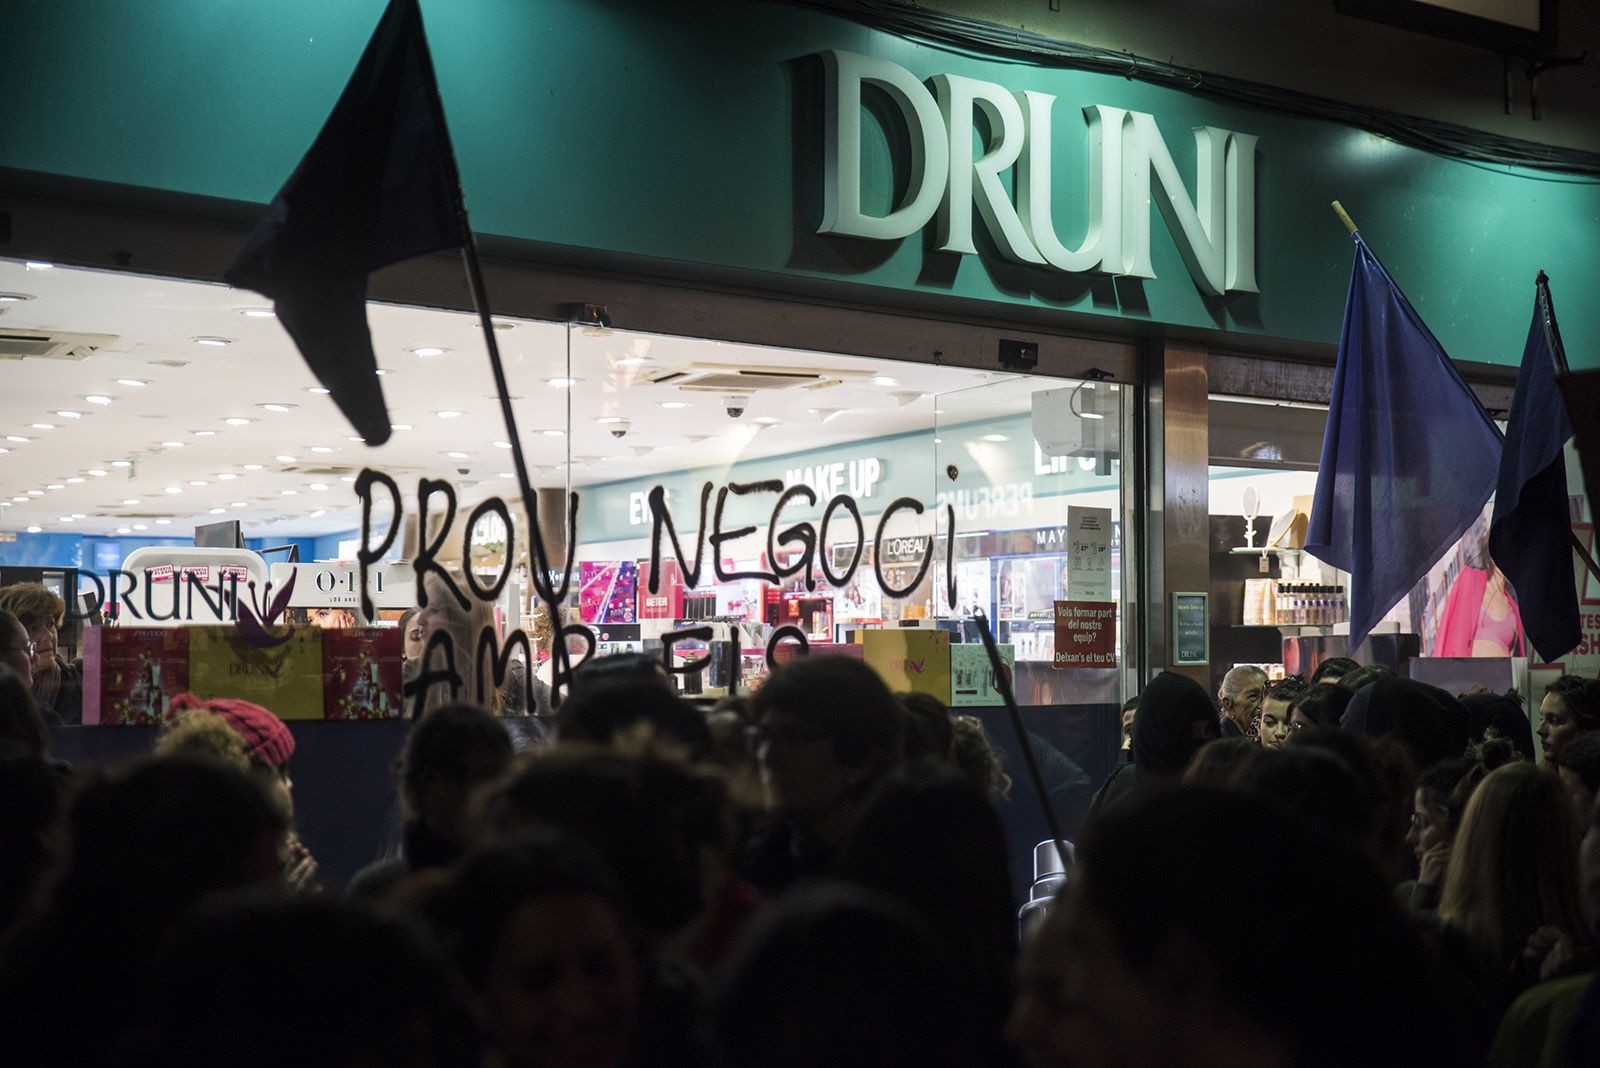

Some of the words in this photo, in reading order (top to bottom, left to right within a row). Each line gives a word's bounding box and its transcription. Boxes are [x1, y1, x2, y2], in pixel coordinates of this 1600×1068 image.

[816, 49, 1260, 296] DRUNI
[785, 462, 845, 506] MAKE
[850, 457, 880, 498] UP
[648, 464, 959, 610] NEGOCI
[64, 569, 240, 621] DRUNI
[1058, 606, 1073, 617] Vols
[1074, 607, 1097, 618] formar
[1098, 608, 1112, 619] part
[1068, 620, 1079, 629] del
[1080, 620, 1102, 630] nostre
[1073, 632, 1096, 644] equip?
[1056, 652, 1085, 662] Deixan's
[1086, 652, 1093, 662] el
[1094, 652, 1104, 662] teu
[1106, 652, 1115, 663] CV
